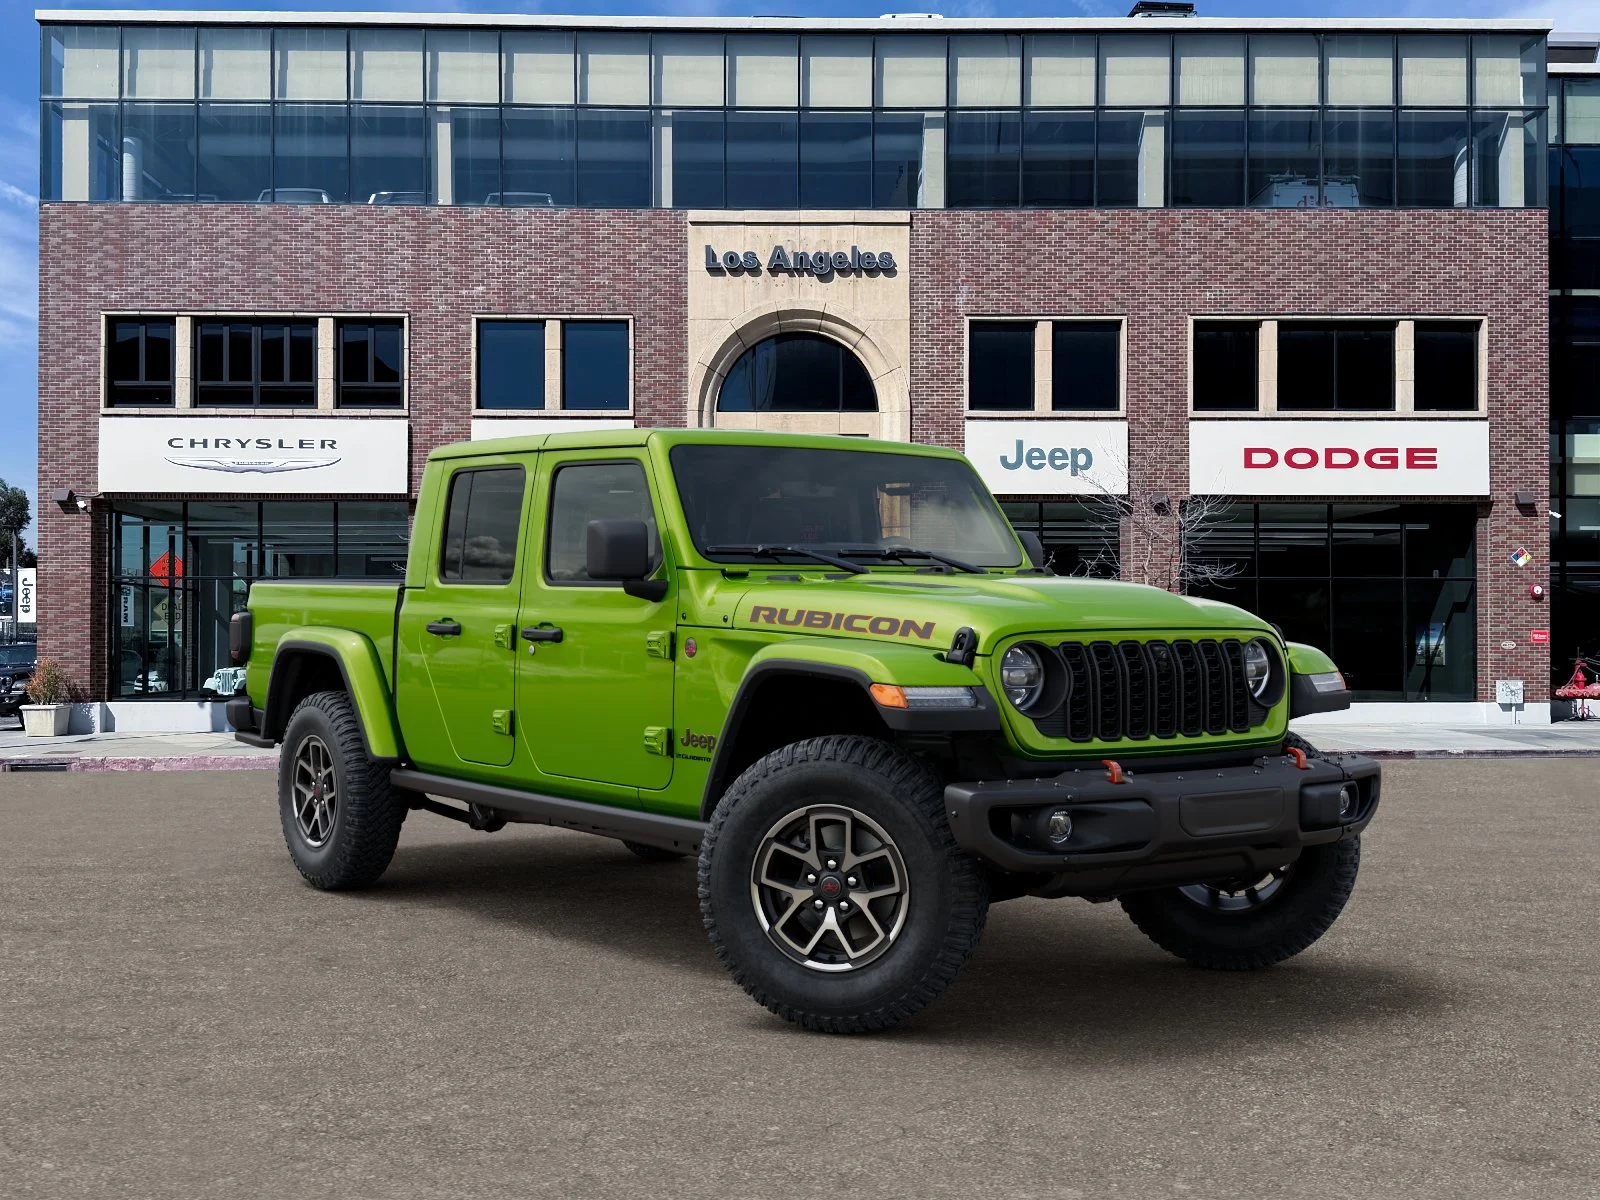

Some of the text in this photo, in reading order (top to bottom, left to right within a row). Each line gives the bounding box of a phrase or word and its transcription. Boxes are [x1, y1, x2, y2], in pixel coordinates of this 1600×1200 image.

[1297, 194, 1334, 207] dih
[705, 245, 895, 276] Los Angeles
[168, 438, 337, 450] CHRYSLER
[1000, 439, 1093, 476] Jeep
[1244, 447, 1437, 469] DODGE
[20, 577, 33, 614] Jeep
[165, 612, 181, 620] ED
[750, 605, 936, 640] RUBICON
[680, 728, 717, 753] Jeep
